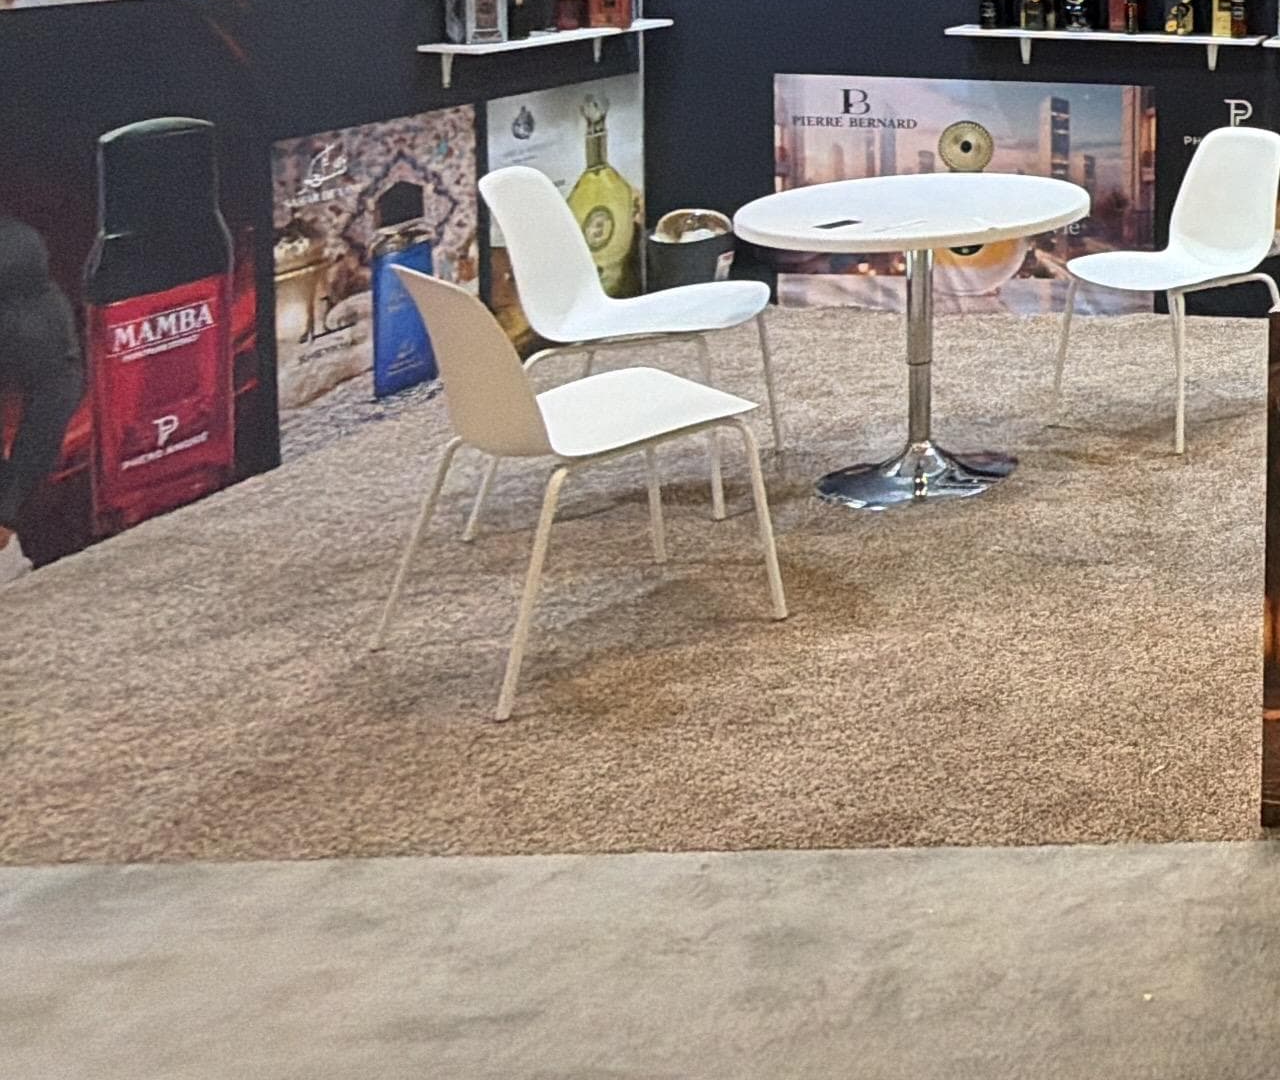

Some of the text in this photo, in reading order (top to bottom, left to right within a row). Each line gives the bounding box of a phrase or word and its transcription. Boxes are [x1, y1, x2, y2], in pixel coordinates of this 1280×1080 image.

[791, 115, 918, 130] PIERRE BERNARD
[112, 303, 215, 353] MAMBA
